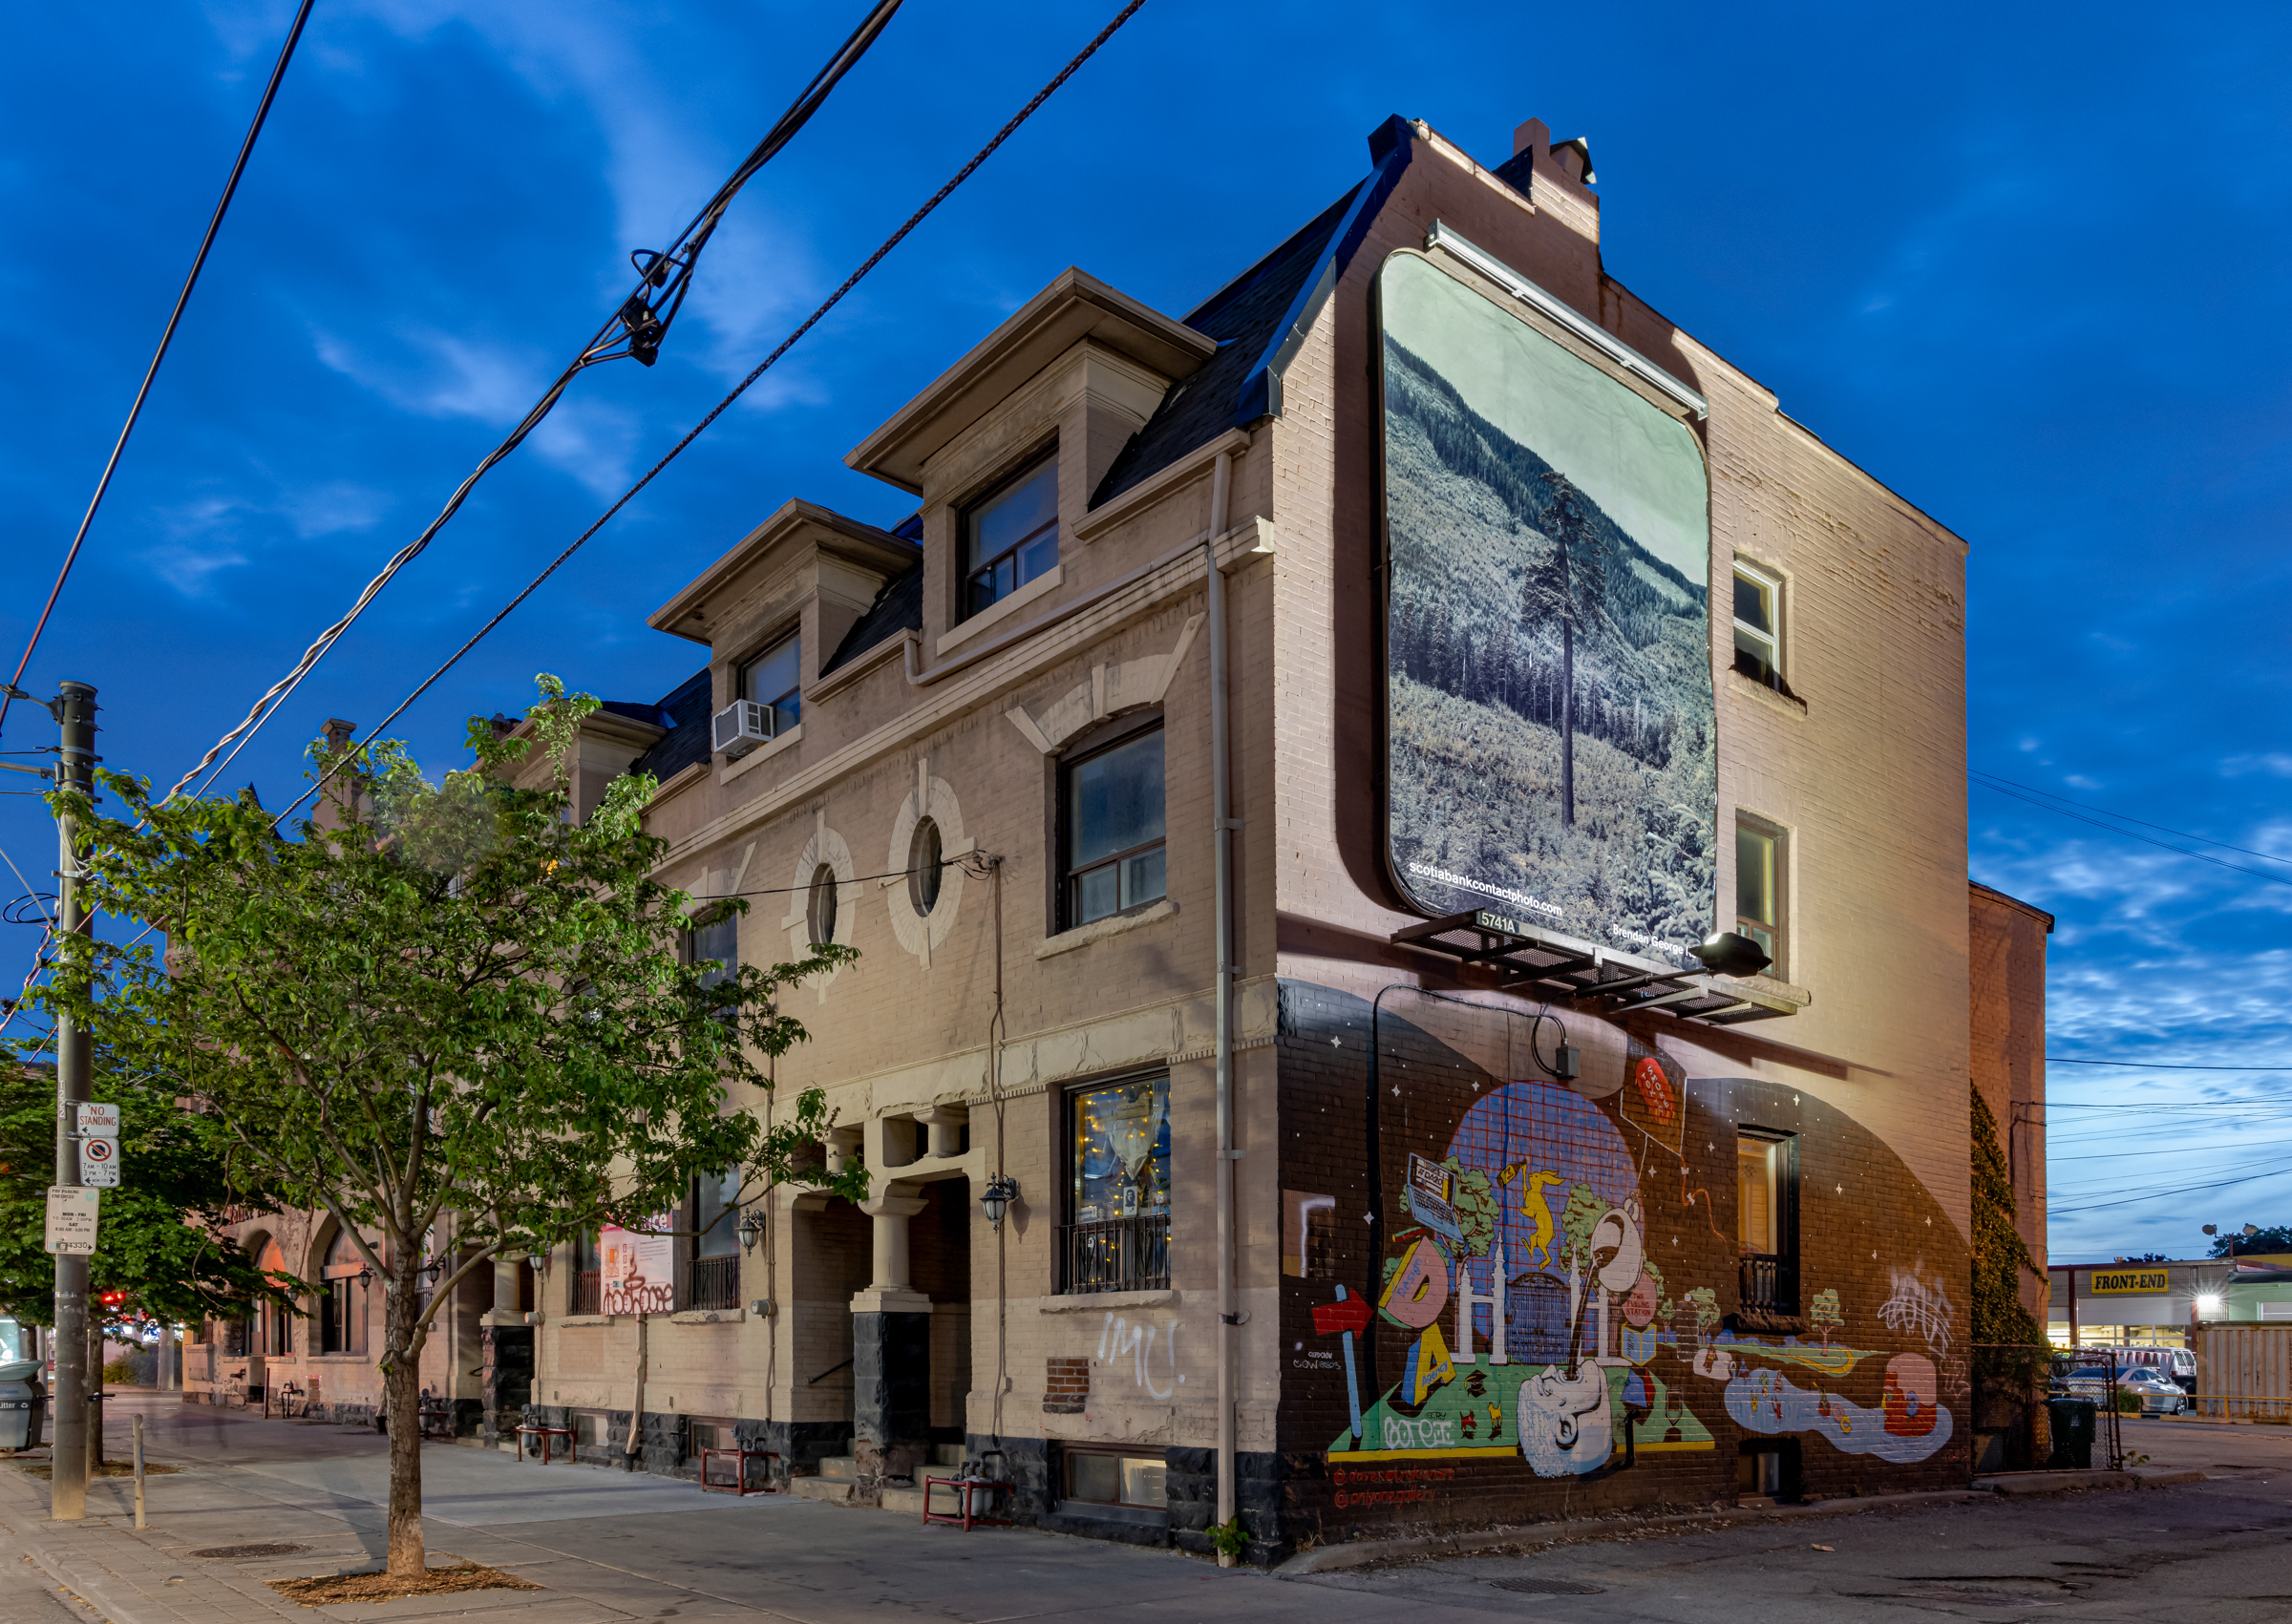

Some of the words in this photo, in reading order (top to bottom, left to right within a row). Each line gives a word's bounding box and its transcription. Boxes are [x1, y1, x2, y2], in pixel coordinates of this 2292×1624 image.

[1409, 862, 1562, 917] scotiabankcontactphoto.com
[1481, 912, 1517, 934] 5741A
[1613, 923, 1649, 945] Brendan
[1651, 936, 1684, 955] George
[1647, 1065, 1669, 1107] SMOKE
[79, 1116, 117, 1126] STANDING
[91, 1107, 105, 1115] NO
[1396, 1257, 1423, 1298] Design
[2094, 1274, 2166, 1290] FRONT-END
[1626, 1300, 1650, 1309] FUELING
